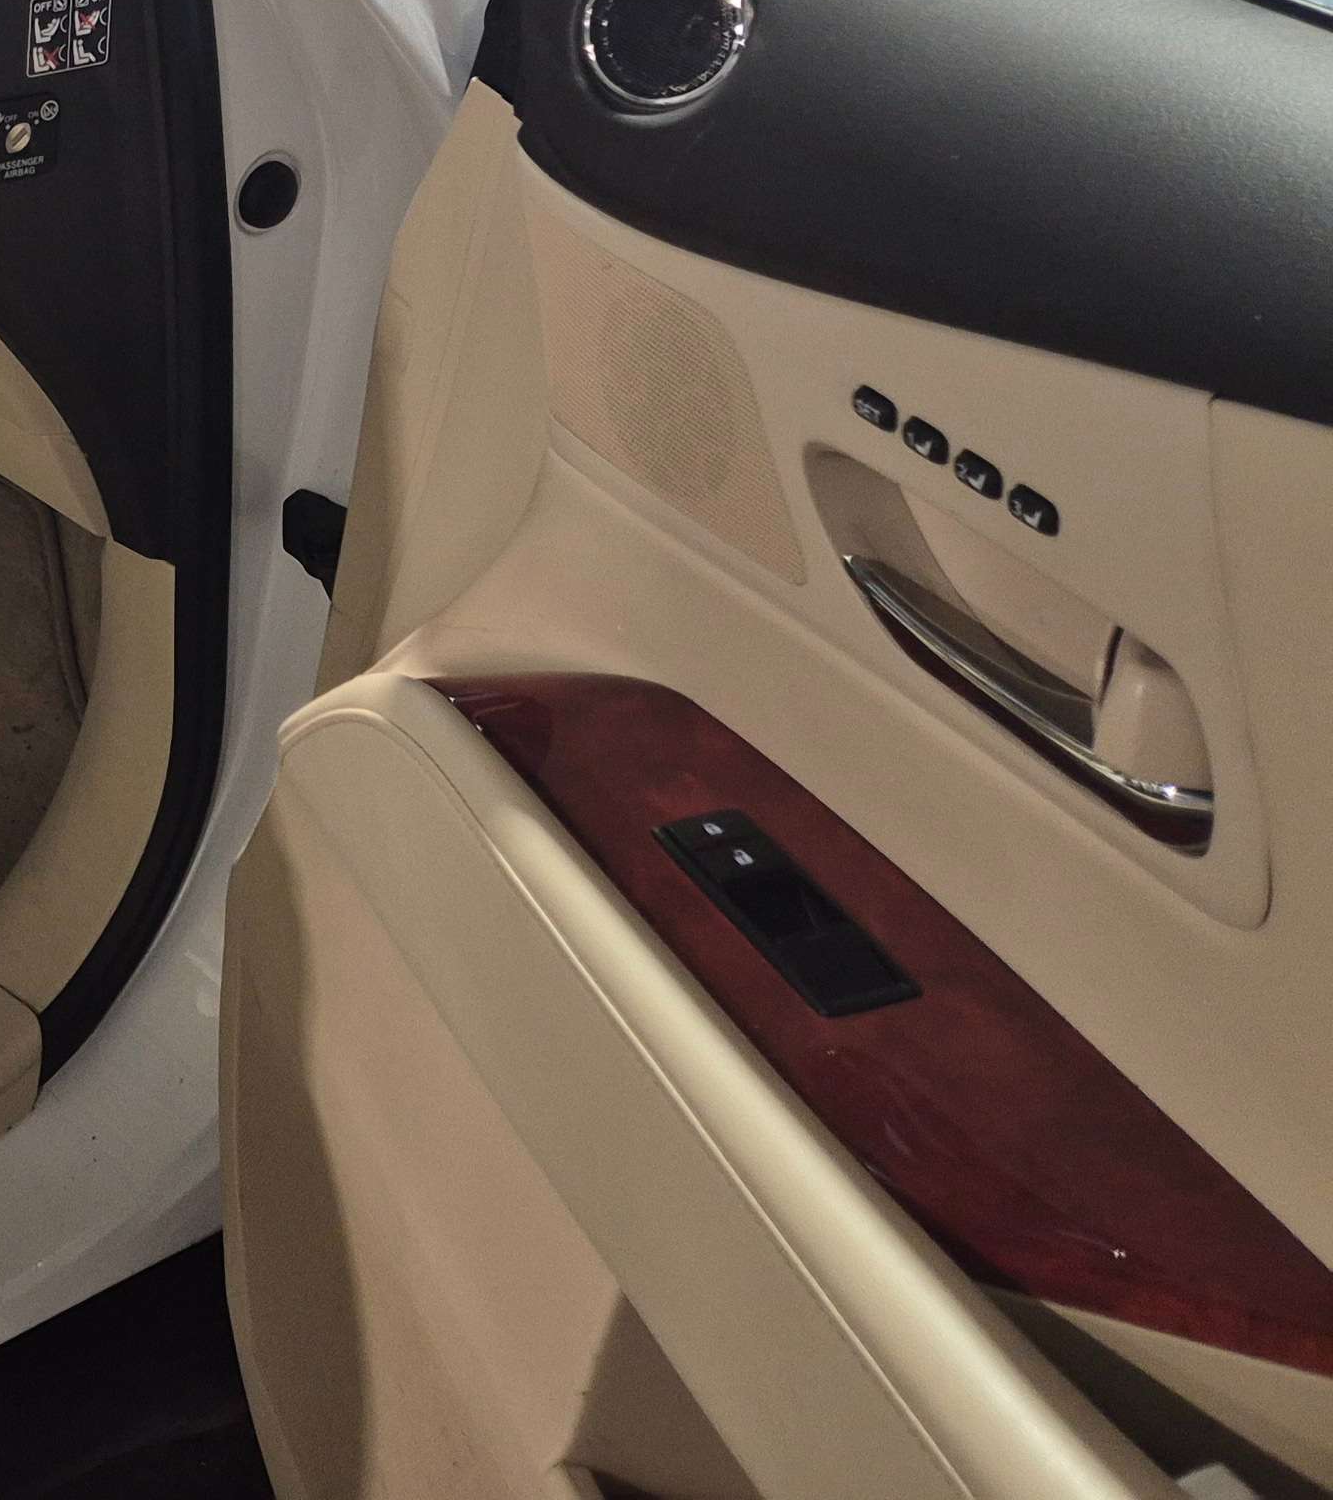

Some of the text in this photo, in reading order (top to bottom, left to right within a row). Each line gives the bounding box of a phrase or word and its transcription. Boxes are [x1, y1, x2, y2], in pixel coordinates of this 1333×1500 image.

[33, 0, 52, 13] OFF
[4, 114, 18, 123] OFF
[3, 166, 36, 179] AIRBAG
